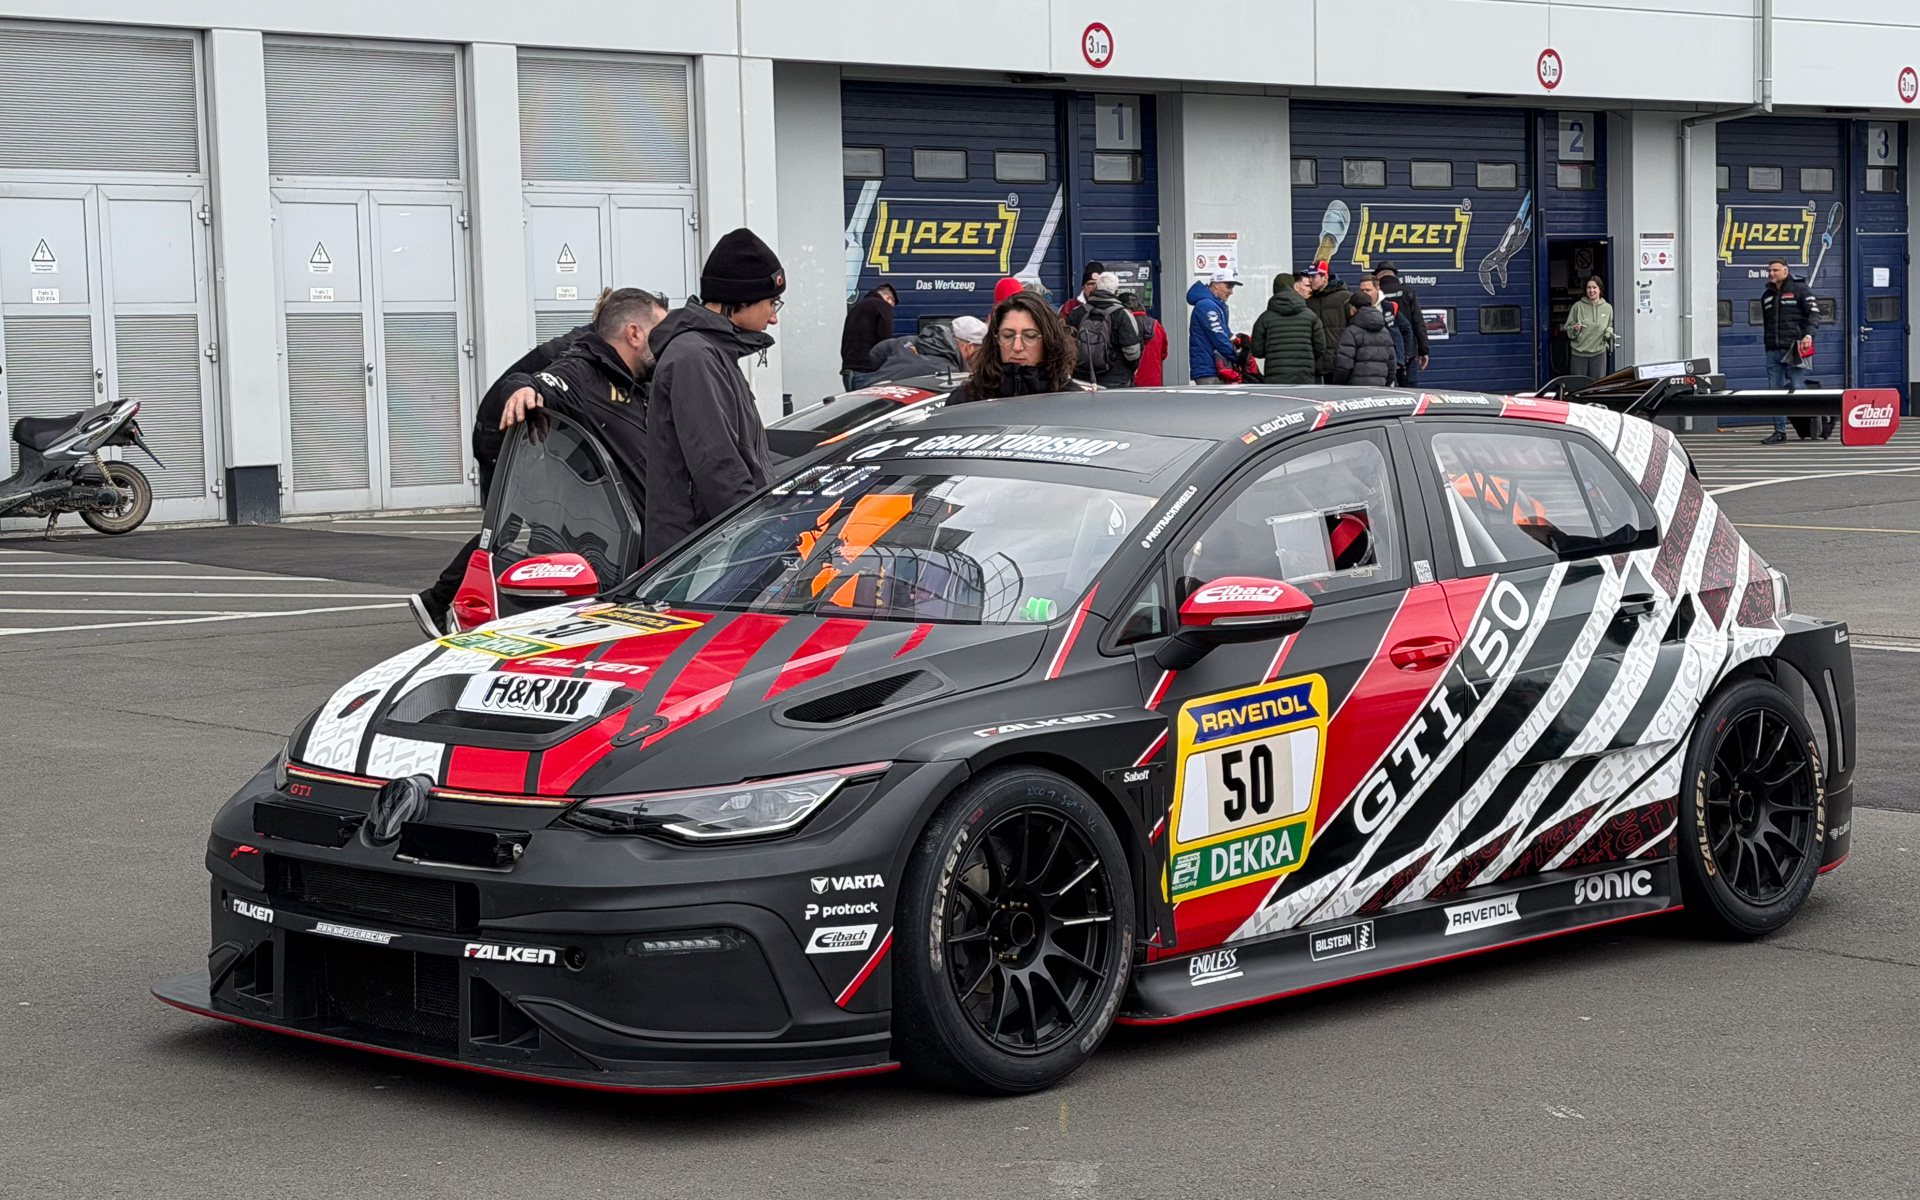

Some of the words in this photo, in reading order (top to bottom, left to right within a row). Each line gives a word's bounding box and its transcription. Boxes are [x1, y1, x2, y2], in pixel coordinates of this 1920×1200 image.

[1111, 103, 1124, 141] 1
[1569, 120, 1585, 153] 2
[1876, 128, 1890, 160] 3
[886, 219, 1002, 254] HAZET
[1367, 222, 1458, 253] HAZET
[1729, 222, 1805, 250] HAZET
[915, 280, 933, 290] Das
[934, 279, 976, 292] Werkzeug
[1404, 275, 1437, 286] Werkzeug
[1330, 396, 1417, 413] Kristoffersson
[1848, 403, 1894, 428] Eibach
[1253, 411, 1306, 437] Leuchter
[912, 434, 1000, 451] GRAN
[994, 434, 1119, 456] TURISMO
[961, 450, 1014, 458] DRIVING
[1013, 452, 1091, 463] SIMULATOR
[510, 563, 586, 581] Eibach
[1194, 585, 1284, 603] Eibach
[1469, 580, 1530, 678] 50
[515, 656, 651, 675] FALKEN
[973, 712, 1117, 738] FALKEN
[1201, 695, 1308, 733] RAVENOL
[1353, 684, 1463, 835] GTI
[290, 783, 312, 797] GTI
[1221, 743, 1275, 823] 50
[1211, 829, 1295, 882] DEKRA
[831, 873, 885, 891] VARTA
[1574, 869, 1653, 906] SONIC
[232, 898, 274, 924] FALKEN
[822, 901, 879, 918] protrack
[1452, 903, 1514, 927] RAVENOL
[815, 929, 868, 948] Eibach
[1315, 934, 1352, 952] BILSTEIN
[464, 943, 557, 965] FALKEN
[1189, 948, 1239, 977] ENDLESS
